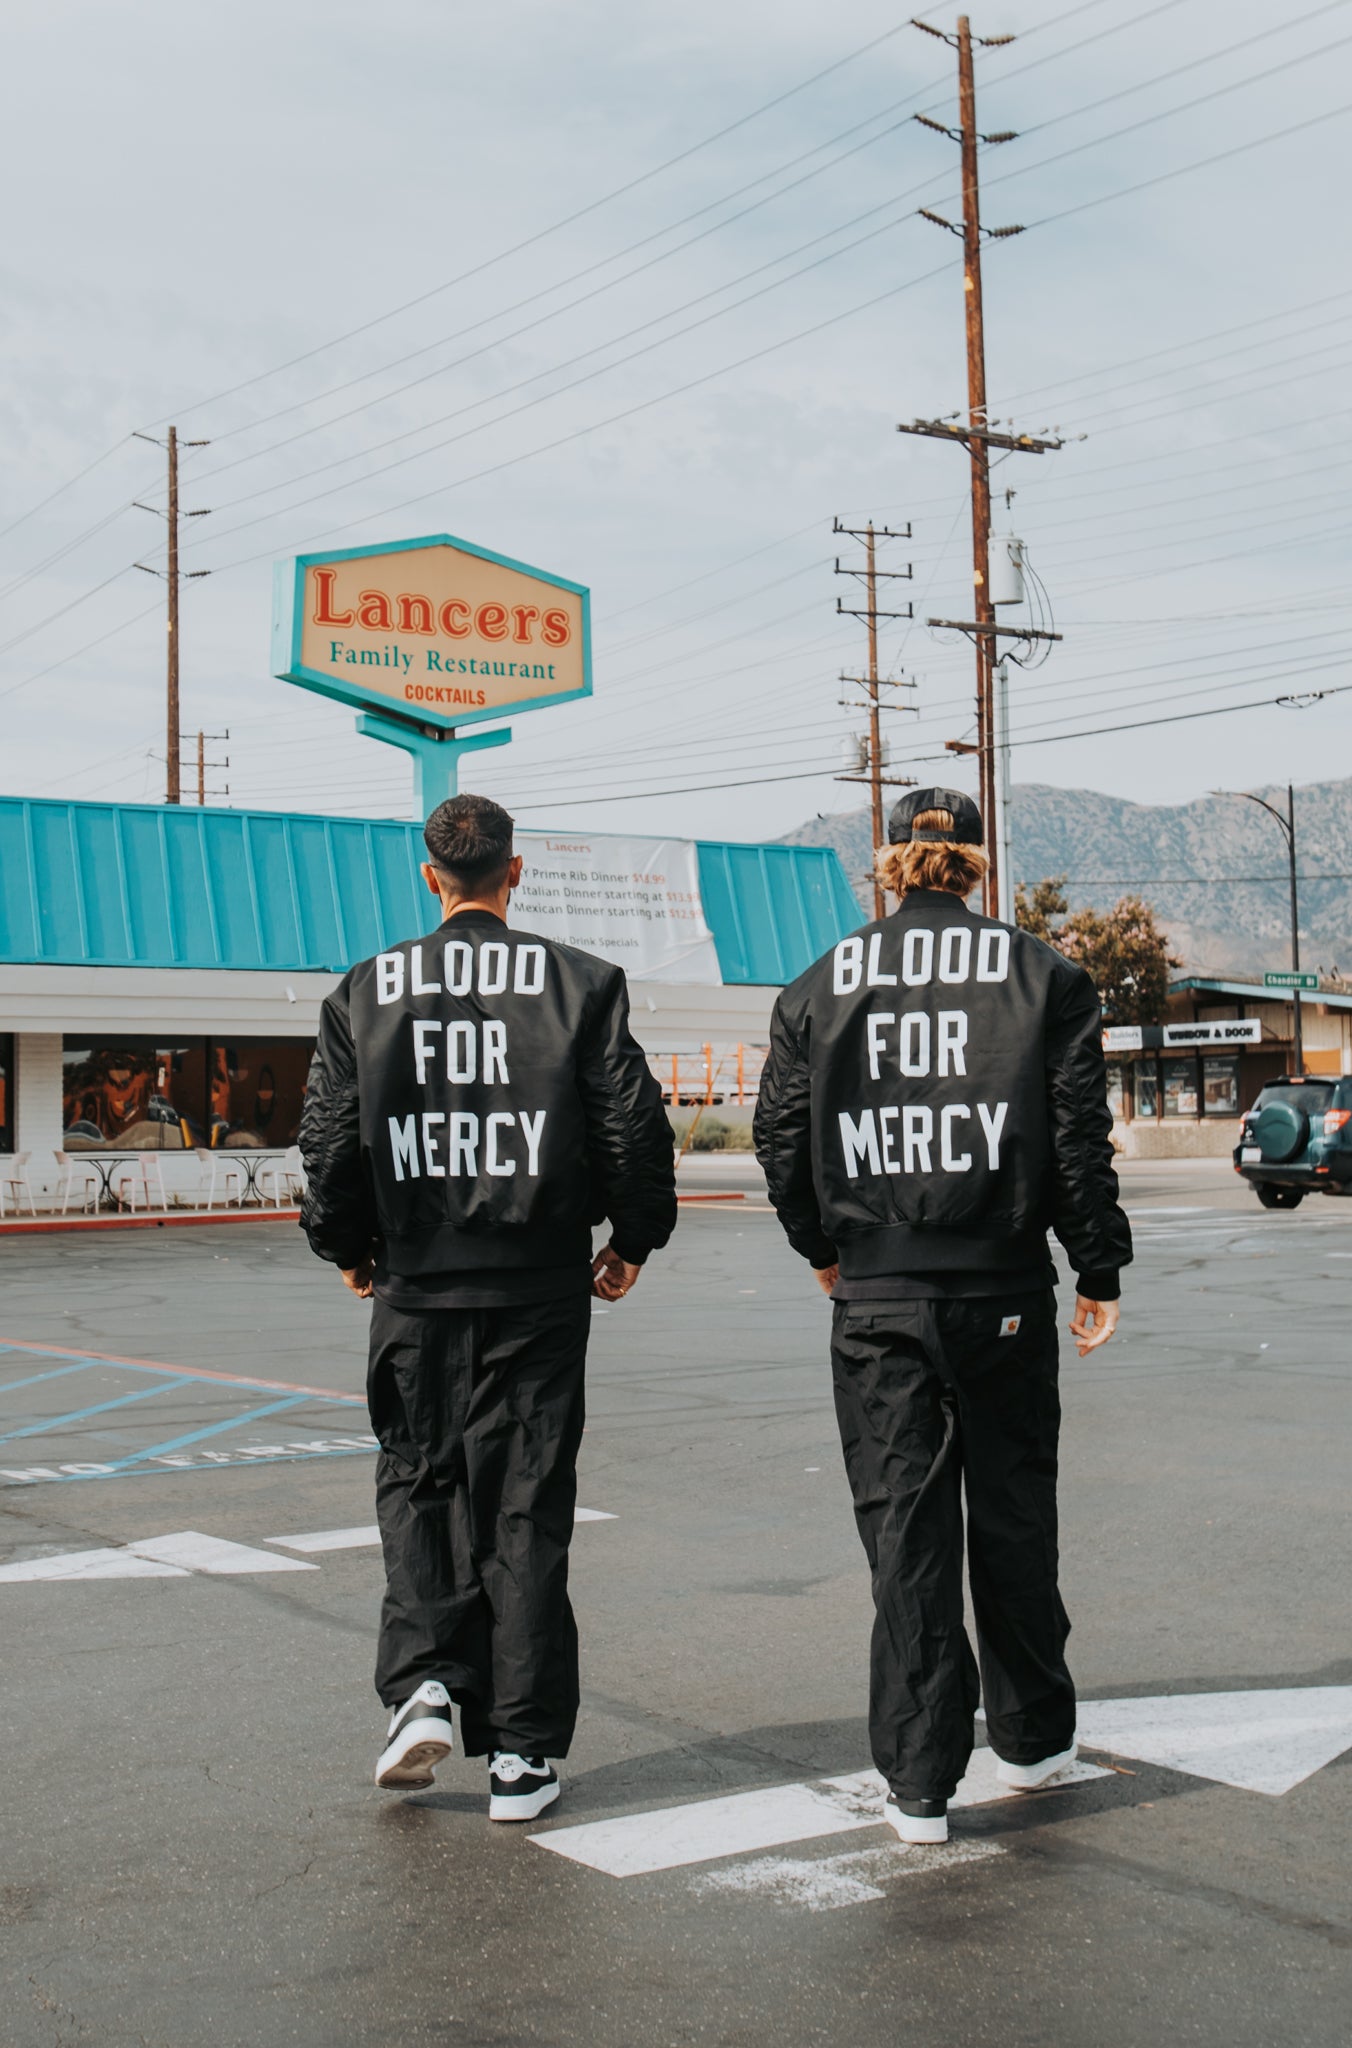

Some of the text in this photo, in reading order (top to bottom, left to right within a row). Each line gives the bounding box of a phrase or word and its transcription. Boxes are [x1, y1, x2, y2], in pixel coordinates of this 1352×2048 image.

[312, 567, 572, 648] Lancers
[329, 641, 556, 680] Family Restaurant
[404, 684, 486, 705] COCKTAILS
[546, 840, 591, 853] Lancers
[522, 885, 560, 897] Italian
[564, 887, 601, 899] Dinner
[605, 891, 649, 904] starting
[652, 893, 662, 902] at
[532, 869, 566, 880] Prime
[570, 871, 587, 881] Rib
[591, 872, 629, 883] Dinner
[514, 903, 563, 914] Mexican
[566, 905, 604, 916] Dinner
[607, 908, 652, 921] starting
[655, 909, 666, 919] at
[569, 936, 596, 946] Drink
[599, 937, 639, 948] Specials
[833, 926, 1011, 996] BLOOD
[376, 940, 547, 1006] BLOOD
[412, 1019, 510, 1085] FOR
[867, 1010, 968, 1080] FOR
[1168, 1028, 1210, 1040] WINDOW
[1225, 1027, 1254, 1038] DOOR
[388, 1110, 547, 1182] MERCY
[838, 1101, 1009, 1179] MERCY
